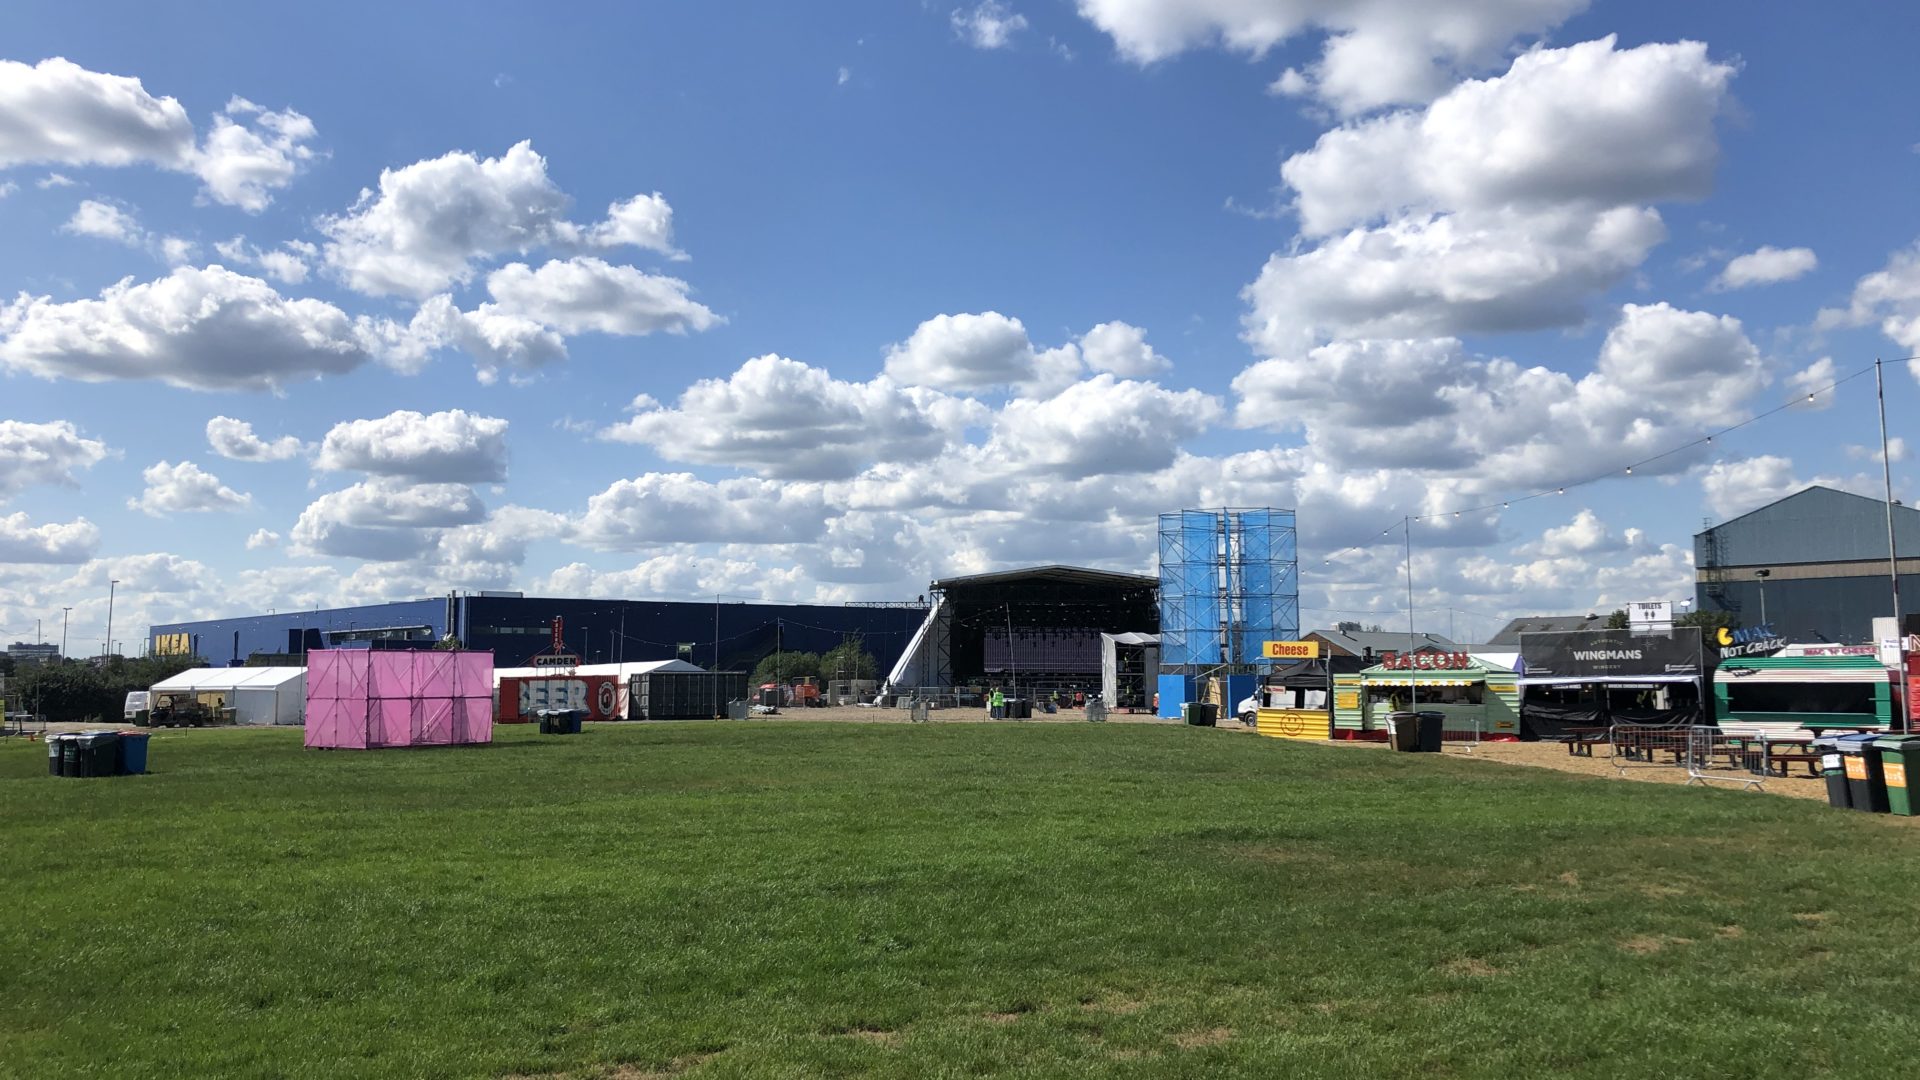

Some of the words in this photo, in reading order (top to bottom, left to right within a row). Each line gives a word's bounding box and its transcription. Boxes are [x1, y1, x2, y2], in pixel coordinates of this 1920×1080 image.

[1733, 623, 1777, 643] MAC
[155, 632, 190, 657] IKEA
[1272, 644, 1309, 655] Cheese
[1720, 646, 1745, 658] NOT
[1382, 650, 1469, 669] BACON
[1573, 650, 1642, 660] WINGMANS
